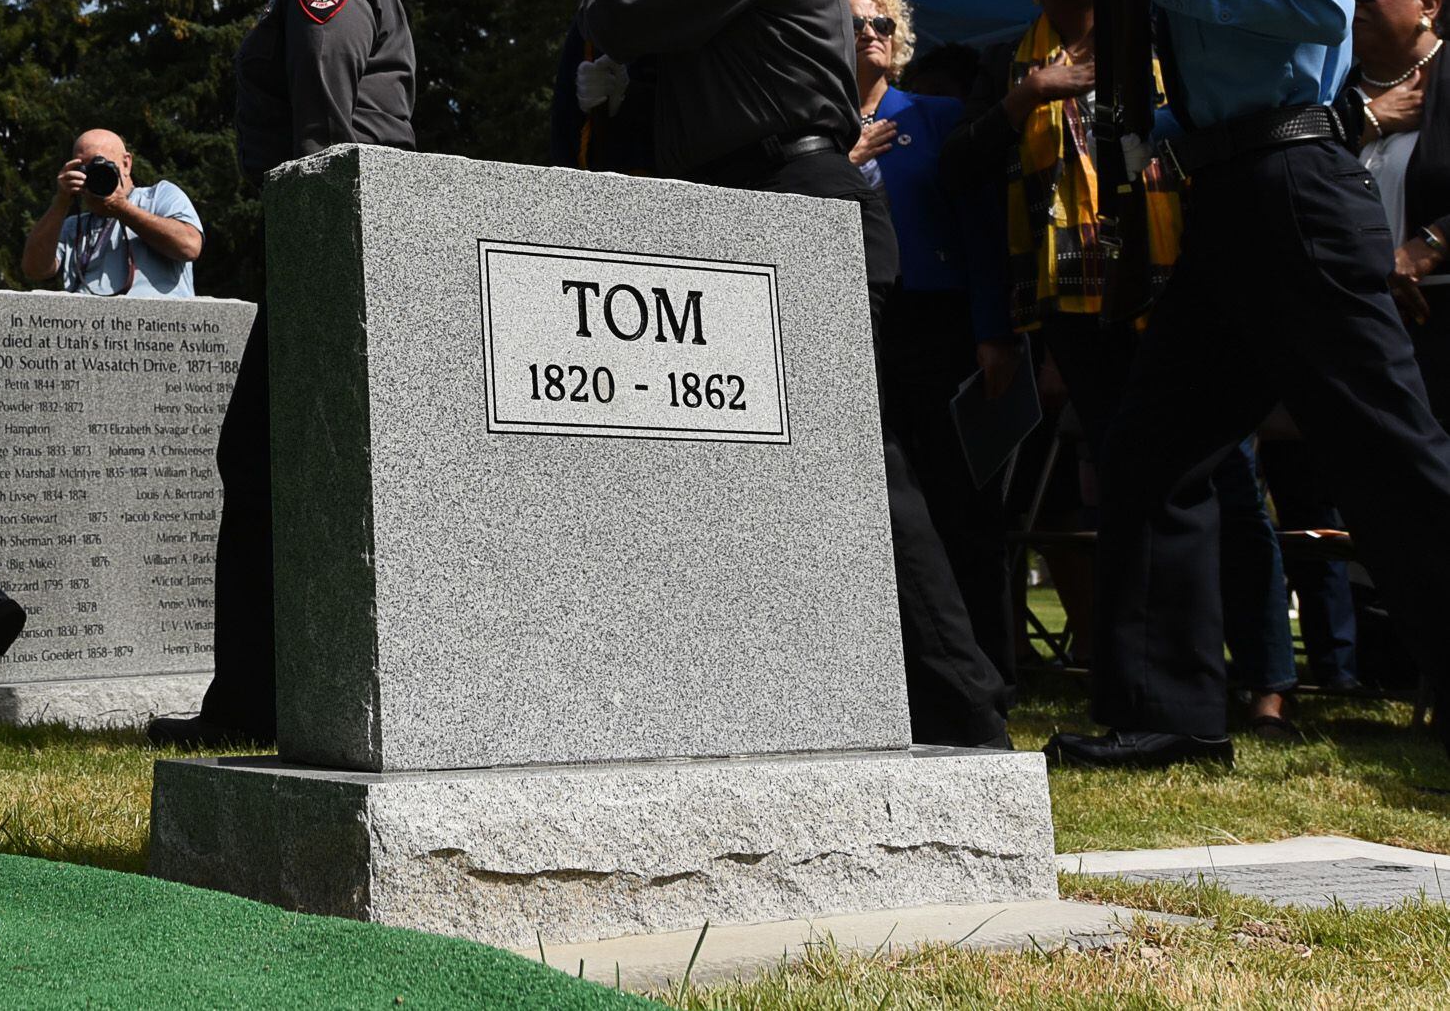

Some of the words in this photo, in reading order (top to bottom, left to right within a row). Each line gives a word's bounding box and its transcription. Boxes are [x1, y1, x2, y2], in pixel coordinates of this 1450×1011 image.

[562, 280, 707, 345] TOM
[11, 314, 23, 327] In
[30, 315, 87, 330] Memory
[91, 316, 105, 330] of
[111, 316, 132, 331] the
[137, 318, 187, 332] Patients
[192, 319, 220, 333] who
[2, 334, 32, 348] died
[38, 336, 50, 348] at
[56, 335, 99, 350] Utah's
[104, 336, 128, 350] first
[134, 338, 174, 351] Insane
[180, 339, 229, 355] Asylum,
[19, 355, 59, 370] South
[64, 359, 76, 370] at
[82, 357, 139, 372] Wasatch
[143, 359, 181, 374] Drive,
[186, 360, 240, 374] 1871-188
[165, 382, 182, 394] Joel
[184, 382, 212, 393] Wood
[529, 363, 616, 403] 1820
[668, 371, 747, 410] 1862
[153, 403, 181, 414] Henry
[184, 403, 213, 414] Stocks
[5, 423, 50, 437] Hampton
[110, 424, 151, 435] Elizabeth
[192, 424, 213, 435] Cole
[13, 445, 42, 457] Straus
[108, 445, 145, 457] Johanna
[161, 446, 214, 456] Christensen
[14, 467, 56, 479] Marshall
[59, 468, 101, 480] McIntyre
[153, 467, 188, 478] William
[191, 467, 213, 480] Pugh
[136, 490, 159, 500] Louis
[175, 489, 214, 500] Bertrand
[21, 513, 58, 525] Stewart
[152, 511, 180, 521] Reese
[10, 535, 53, 547] Sherman
[157, 532, 187, 543] Minnie
[143, 554, 177, 565] William
[0, 579, 39, 592] Blizzard
[187, 575, 213, 587] James
[163, 643, 190, 655] Henry
[13, 652, 38, 663] Louis
[41, 649, 82, 662] Goedert
